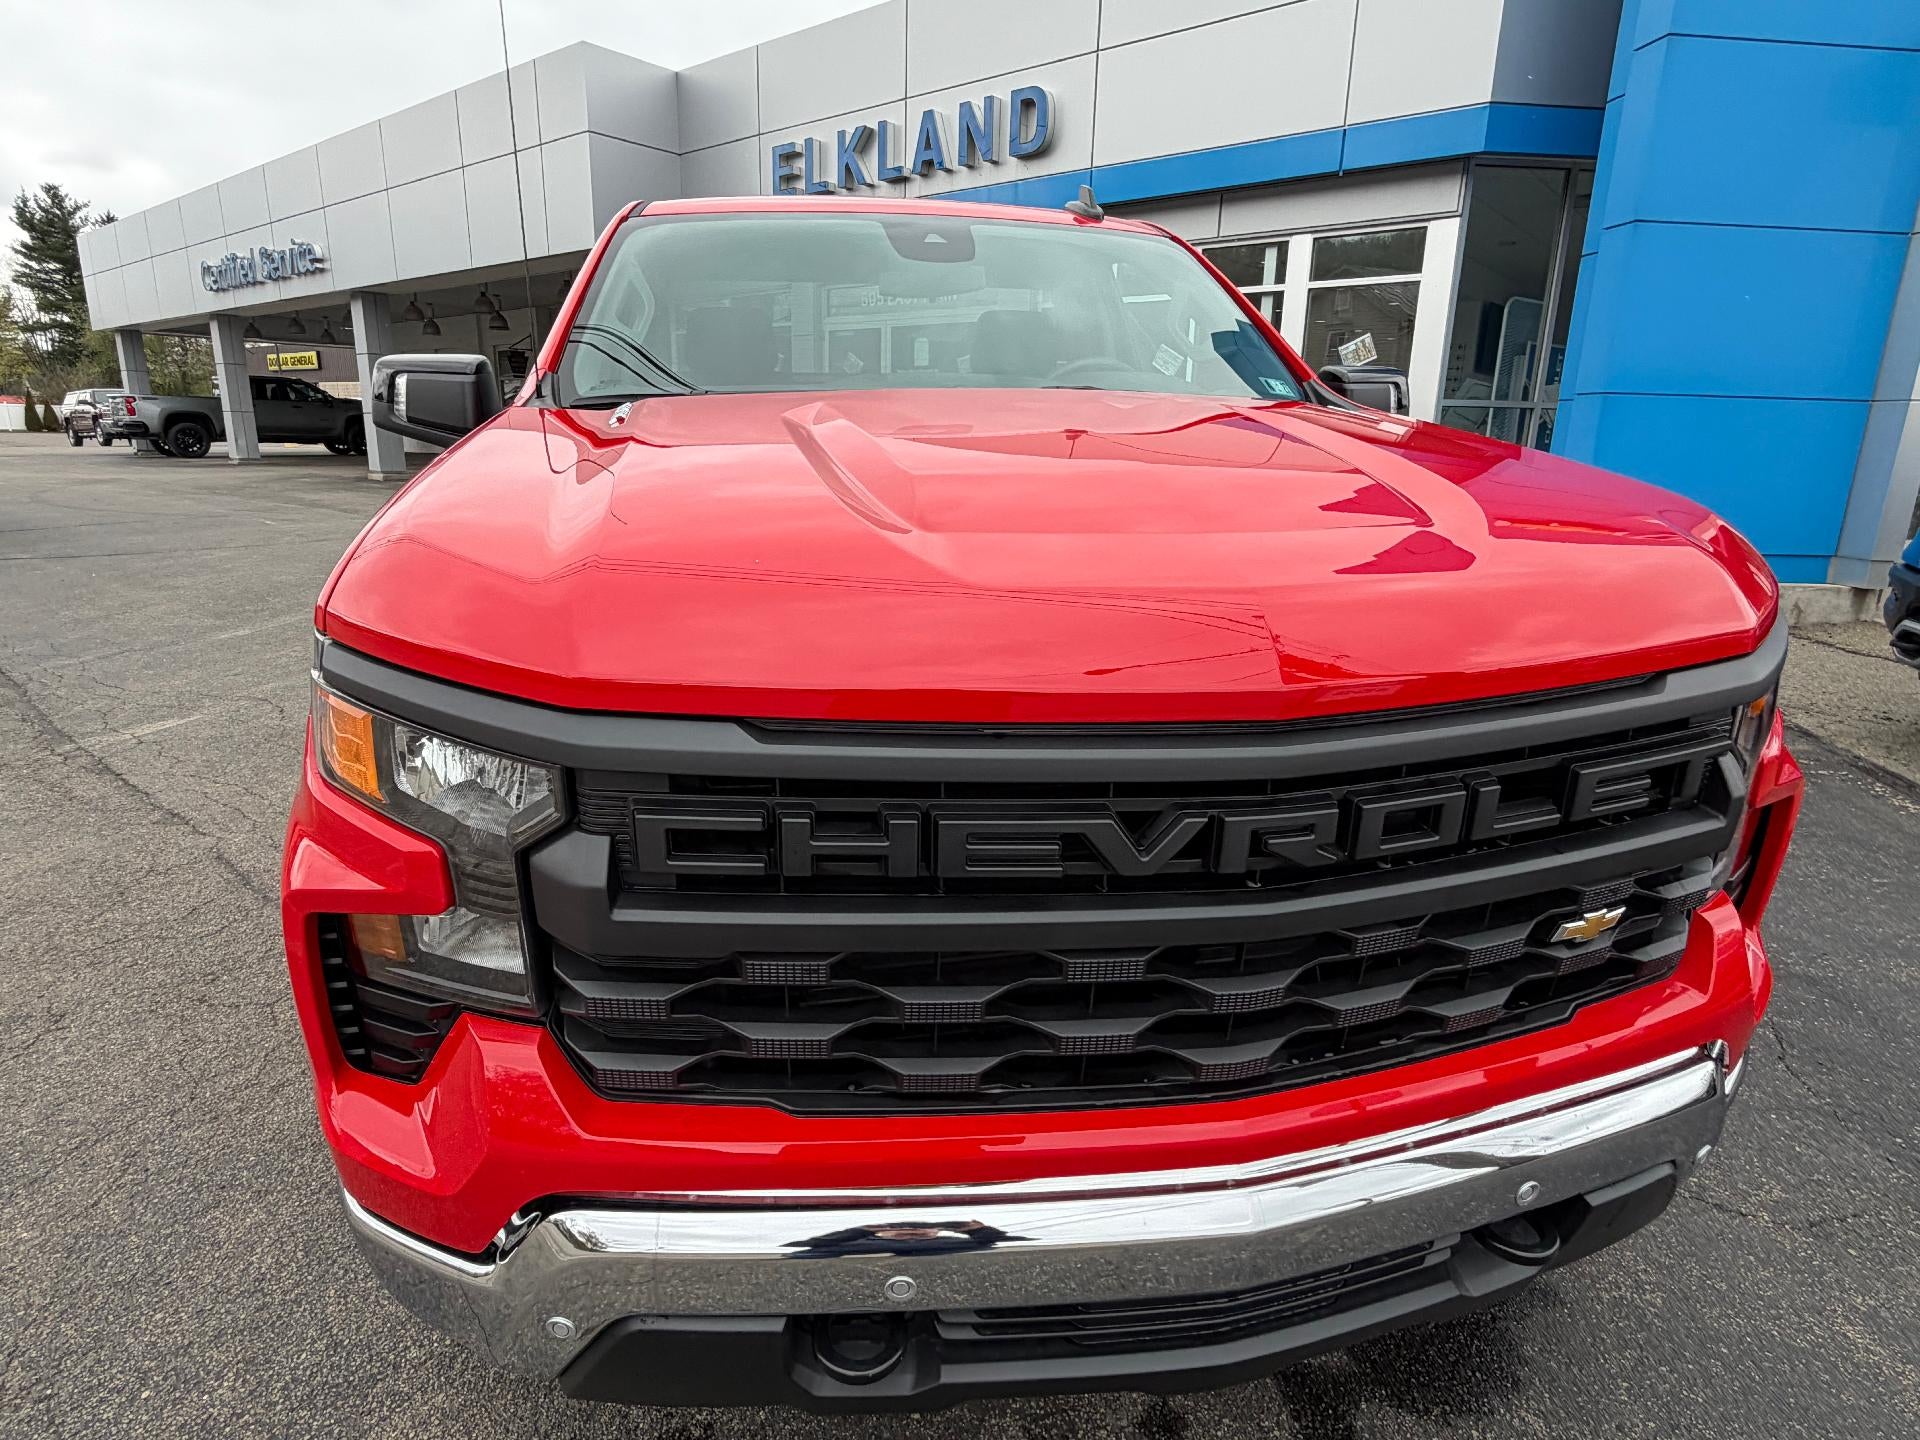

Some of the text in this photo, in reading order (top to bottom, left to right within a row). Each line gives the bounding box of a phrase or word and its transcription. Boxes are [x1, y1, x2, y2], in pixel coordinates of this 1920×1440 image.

[771, 85, 1055, 196] ELKLAND
[200, 238, 326, 292] Certified Service
[268, 354, 316, 368] DOAR GENERAL
